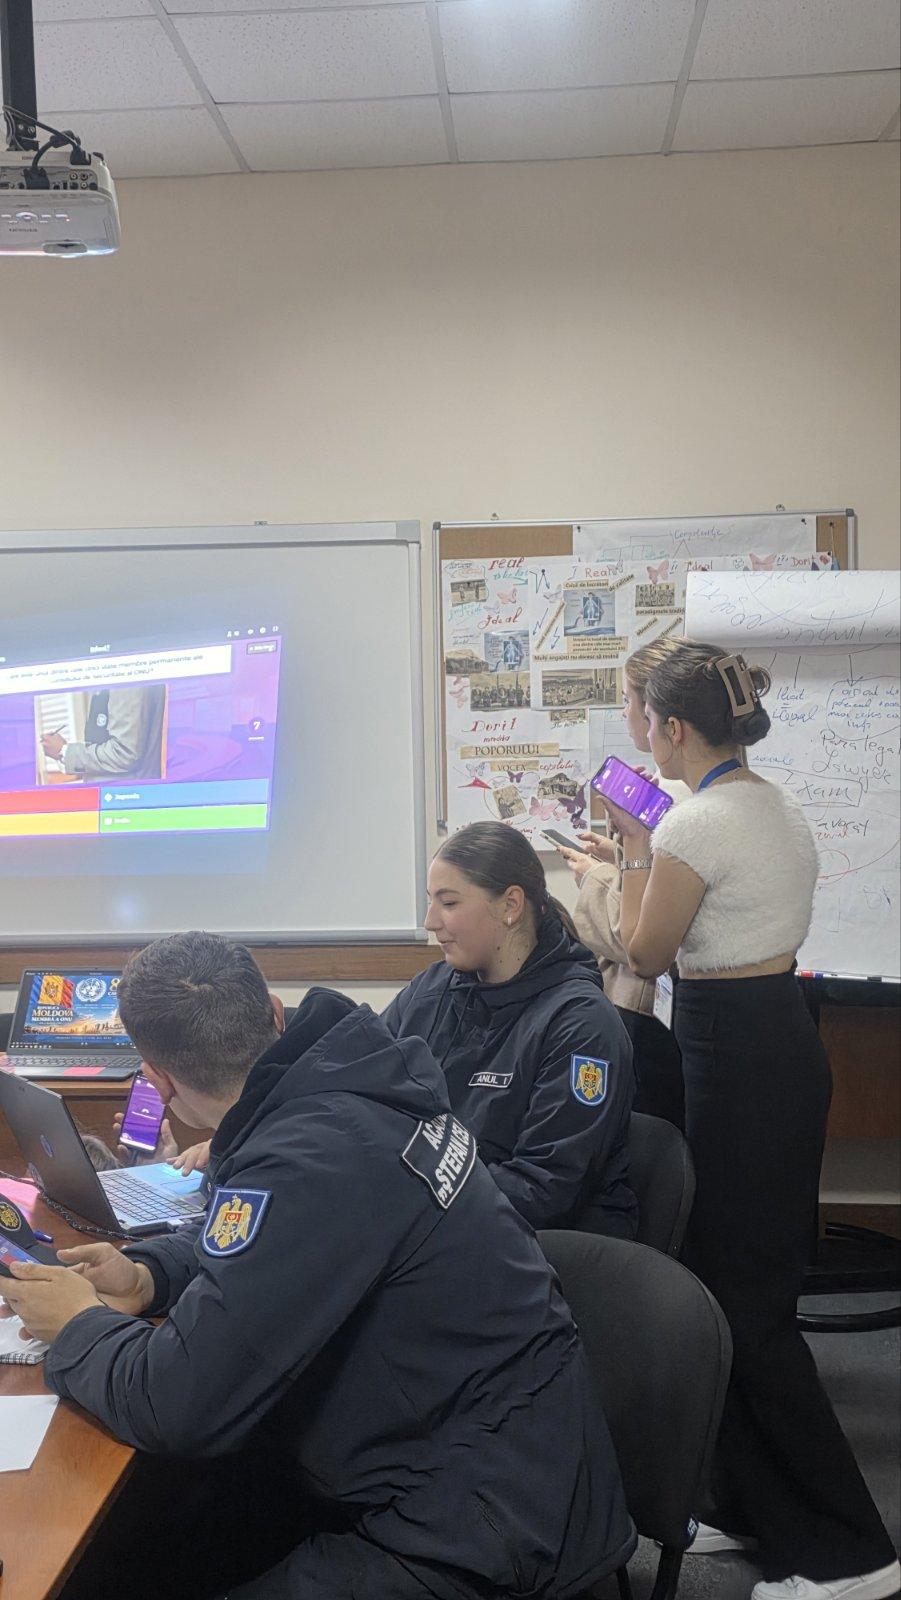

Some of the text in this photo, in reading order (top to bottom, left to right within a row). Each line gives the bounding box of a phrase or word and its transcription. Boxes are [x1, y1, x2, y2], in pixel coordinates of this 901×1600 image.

[475, 744, 540, 756] POPORULUI
[32, 1009, 73, 1017] MOLDOVA
[476, 1075, 498, 1084] ANUL
